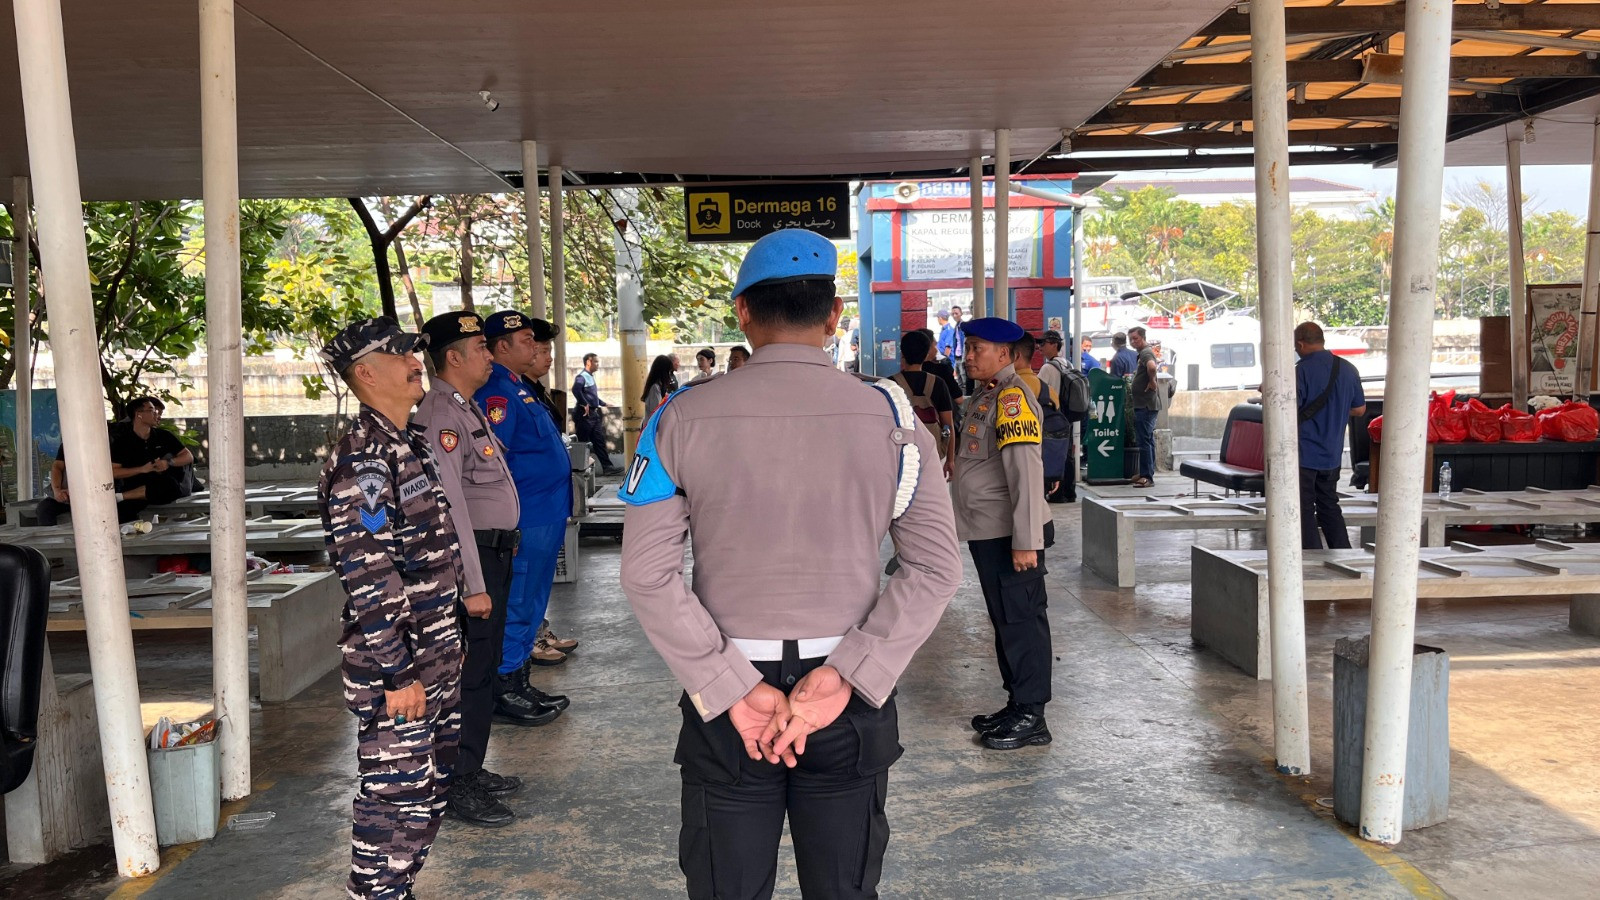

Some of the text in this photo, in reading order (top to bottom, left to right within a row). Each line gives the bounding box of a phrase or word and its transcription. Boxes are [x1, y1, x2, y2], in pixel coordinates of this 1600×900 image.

[734, 197, 837, 216] Dermaga 16
[737, 219, 762, 229] Dock
[911, 228, 938, 236] KAPAL
[1021, 419, 1039, 438] WAS
[1093, 428, 1119, 437] Toilet
[402, 478, 429, 497] WAKIDI
